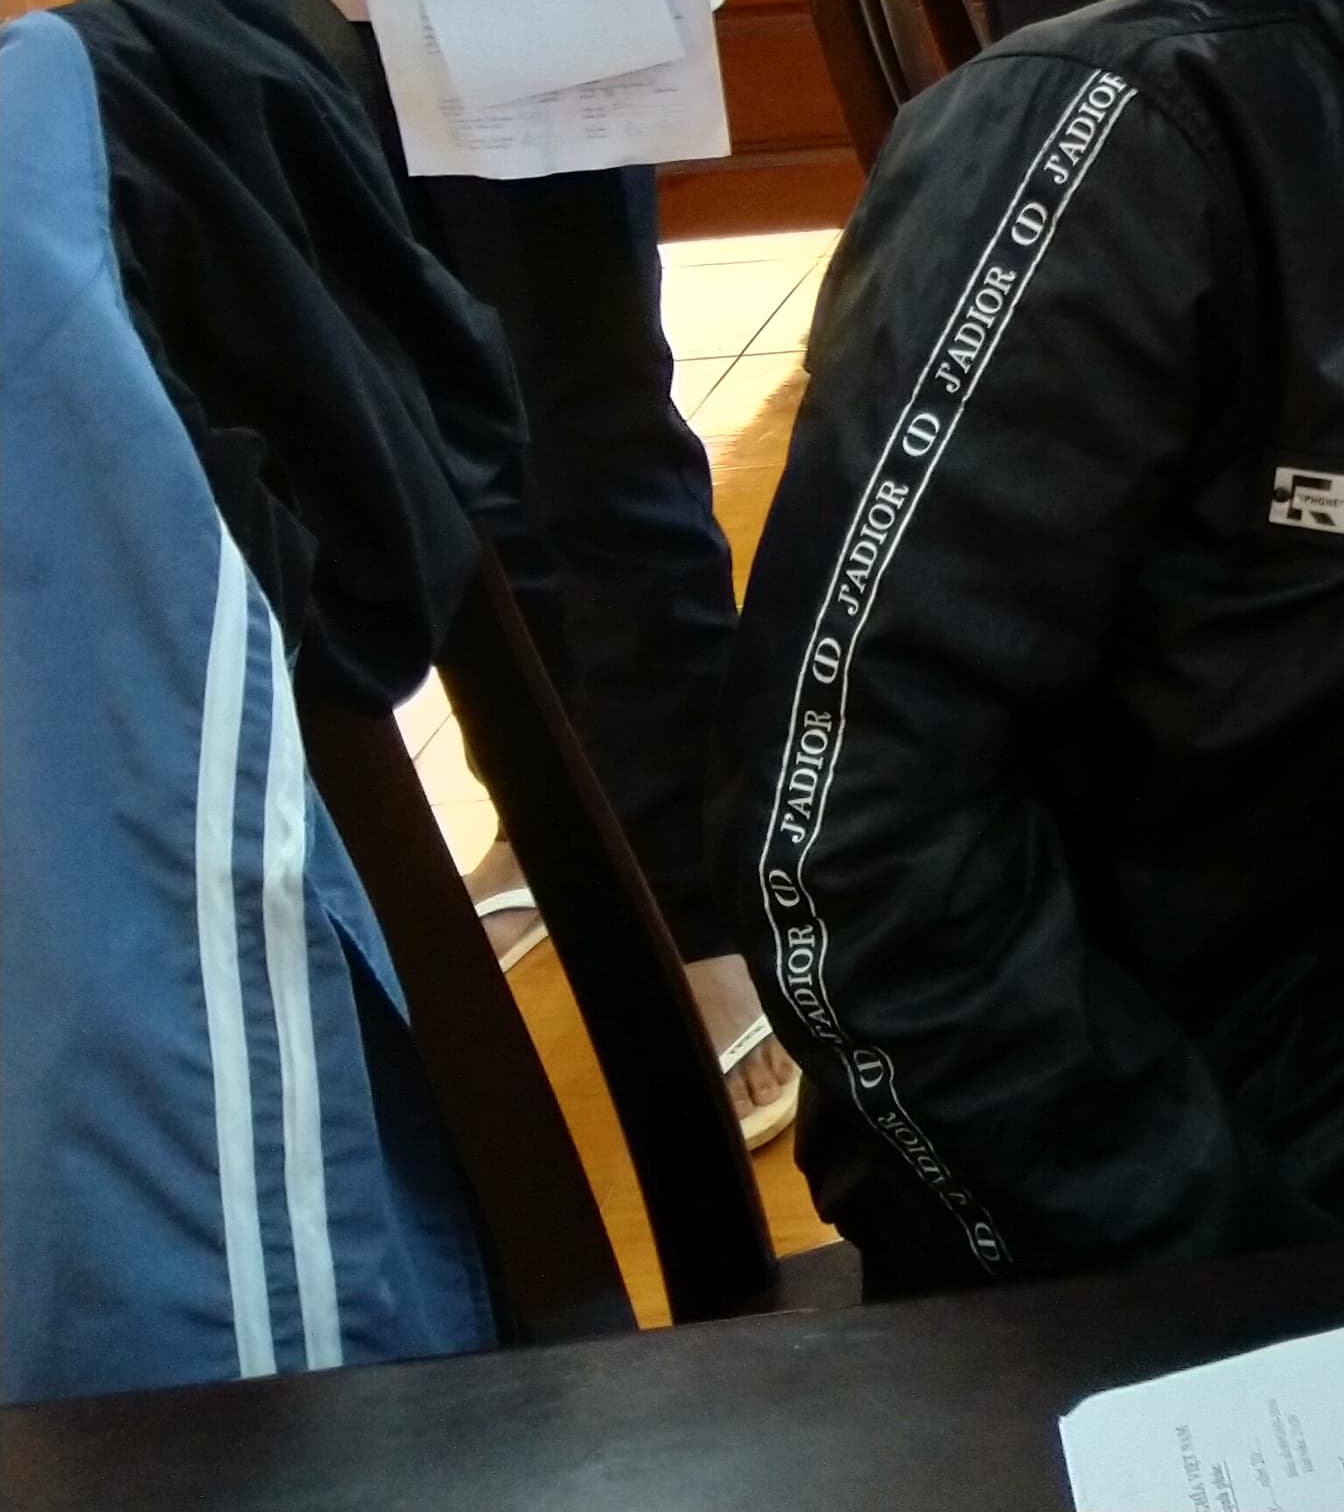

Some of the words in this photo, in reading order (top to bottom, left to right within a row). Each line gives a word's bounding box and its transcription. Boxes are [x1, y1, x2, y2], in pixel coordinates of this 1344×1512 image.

[780, 708, 832, 845] J'ADIOR
[837, 478, 910, 616] J'ADIOR
[934, 264, 1018, 394] J'ADIOR
